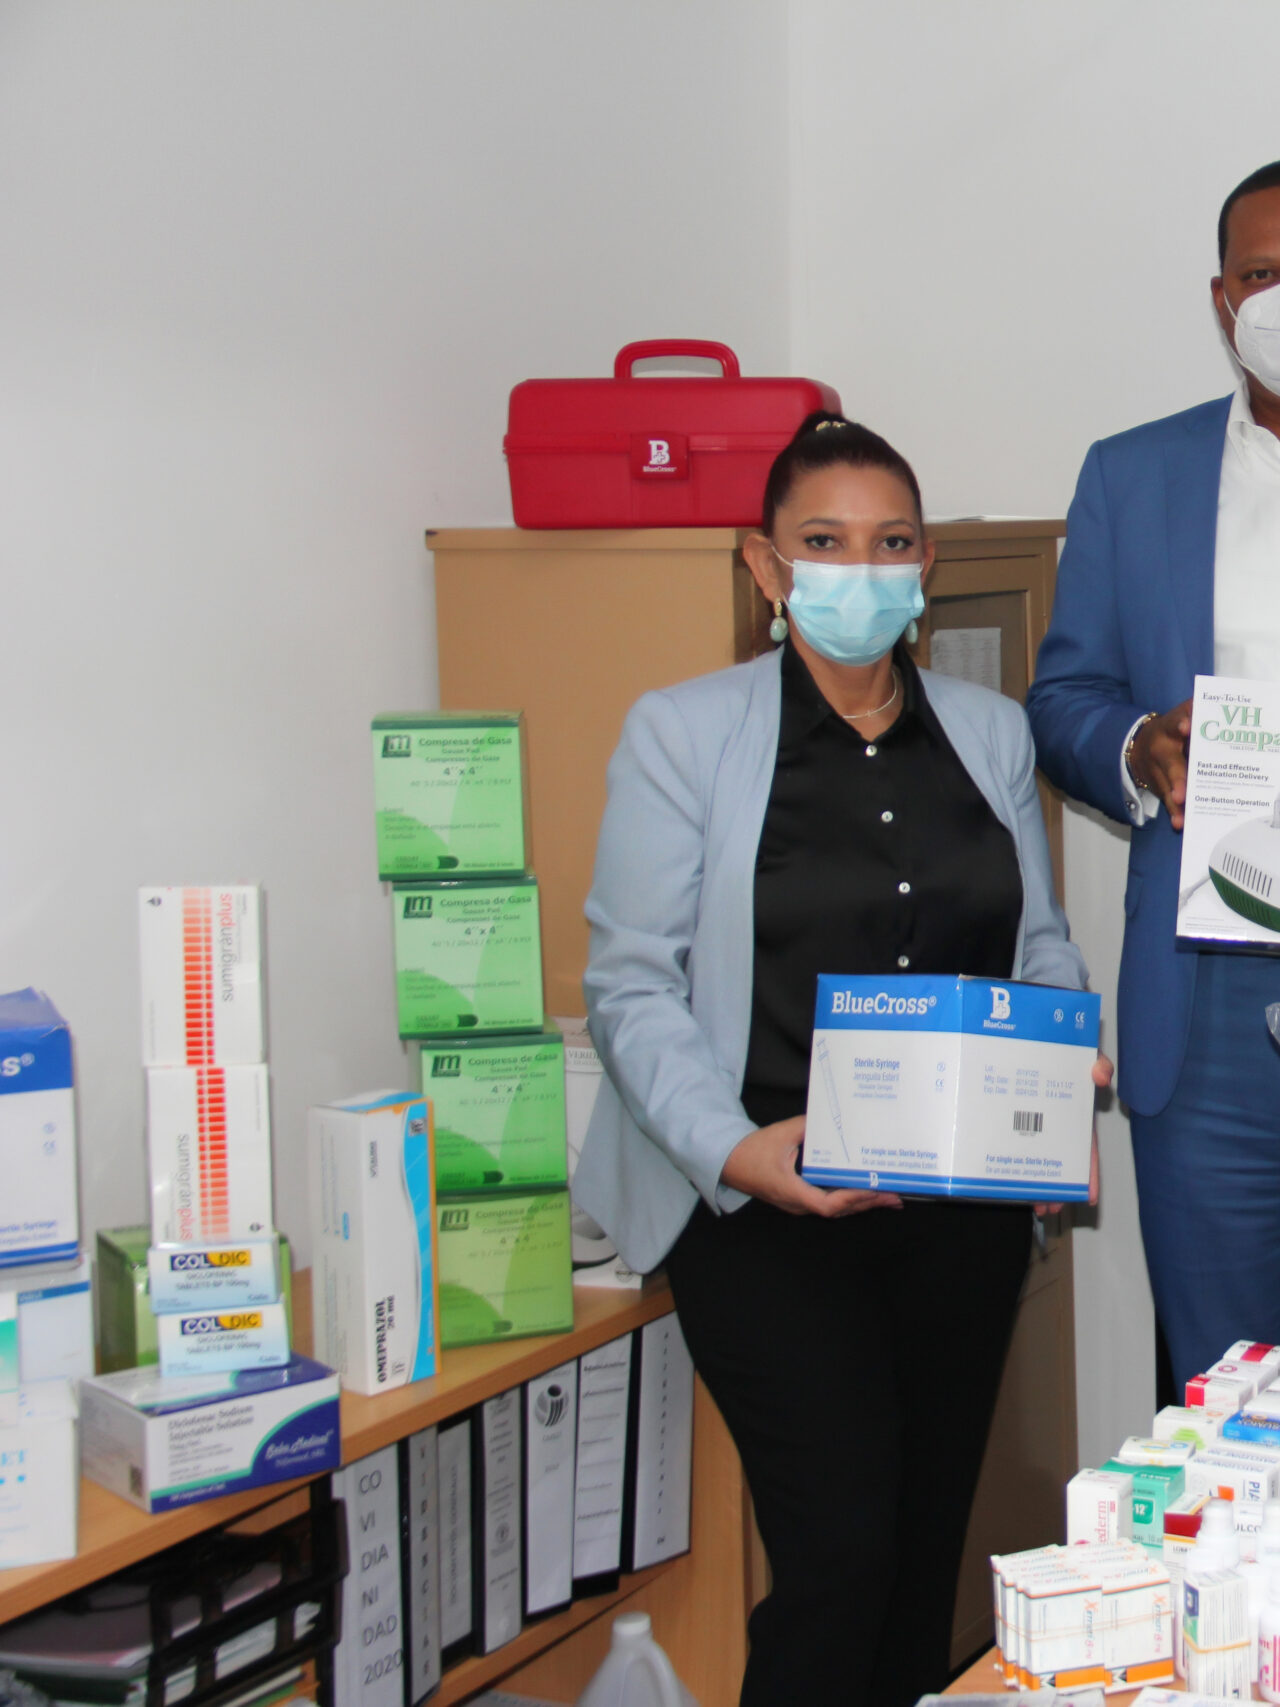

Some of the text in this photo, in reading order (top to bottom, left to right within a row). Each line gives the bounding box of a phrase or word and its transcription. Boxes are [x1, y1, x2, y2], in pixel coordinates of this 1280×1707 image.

[1202, 692, 1252, 704] Easy-To-Use
[1221, 704, 1262, 727] VH
[472, 736, 485, 745] de
[487, 735, 512, 745] Gasa
[1197, 761, 1260, 772] Fast and Effective
[1197, 769, 1269, 781] Medication Delivery
[1195, 795, 1270, 808] One-Button Operation
[493, 896, 506, 905] de
[507, 895, 532, 904] Gasa
[990, 986, 1012, 1020] B
[854, 1058, 900, 1070] Sterile Syringe
[359, 1469, 383, 1495] CO
[360, 1511, 377, 1533] VI
[361, 1543, 390, 1573] DIA
[362, 1584, 380, 1609] NI
[363, 1614, 399, 1647] DAD
[363, 1648, 403, 1685] 2020
